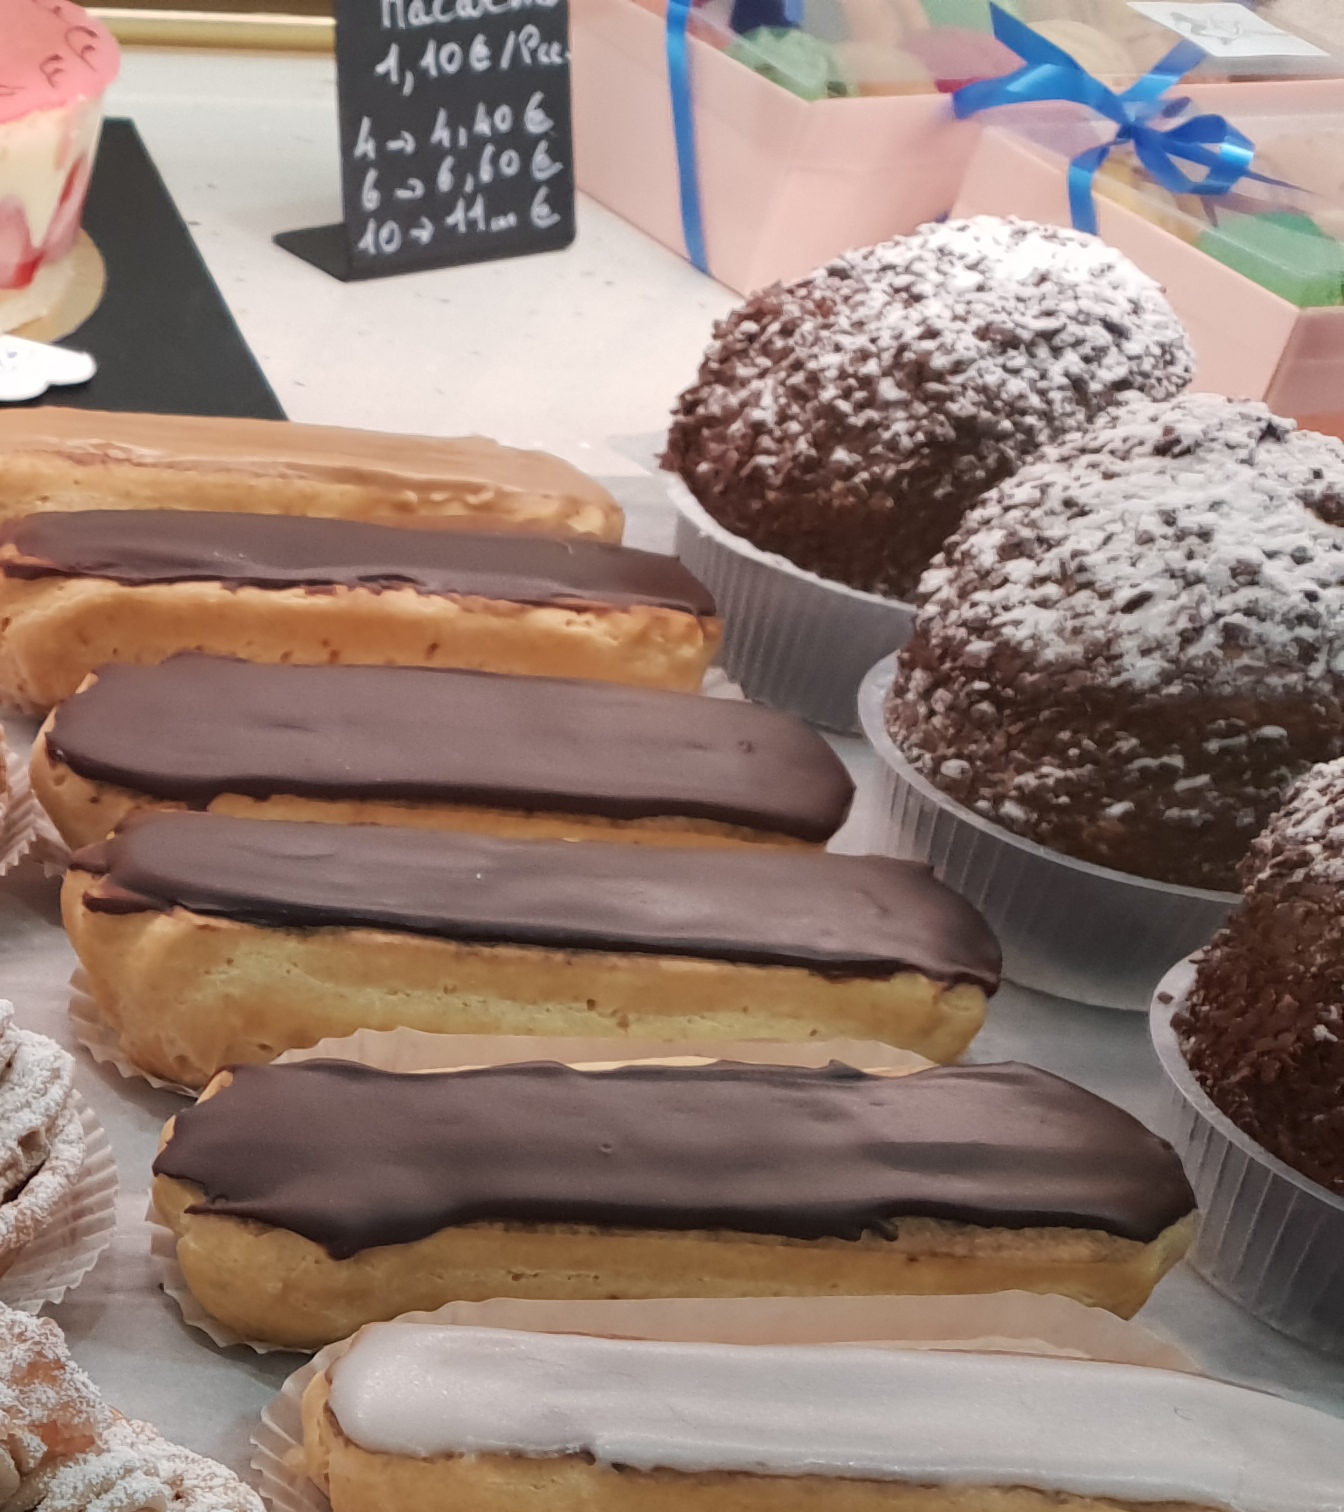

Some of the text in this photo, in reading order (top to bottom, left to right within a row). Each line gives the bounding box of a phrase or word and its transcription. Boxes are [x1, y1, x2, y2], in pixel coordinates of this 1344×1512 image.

[353, 116, 376, 159] 4
[363, 167, 381, 212] 6
[357, 218, 402, 254] 10
